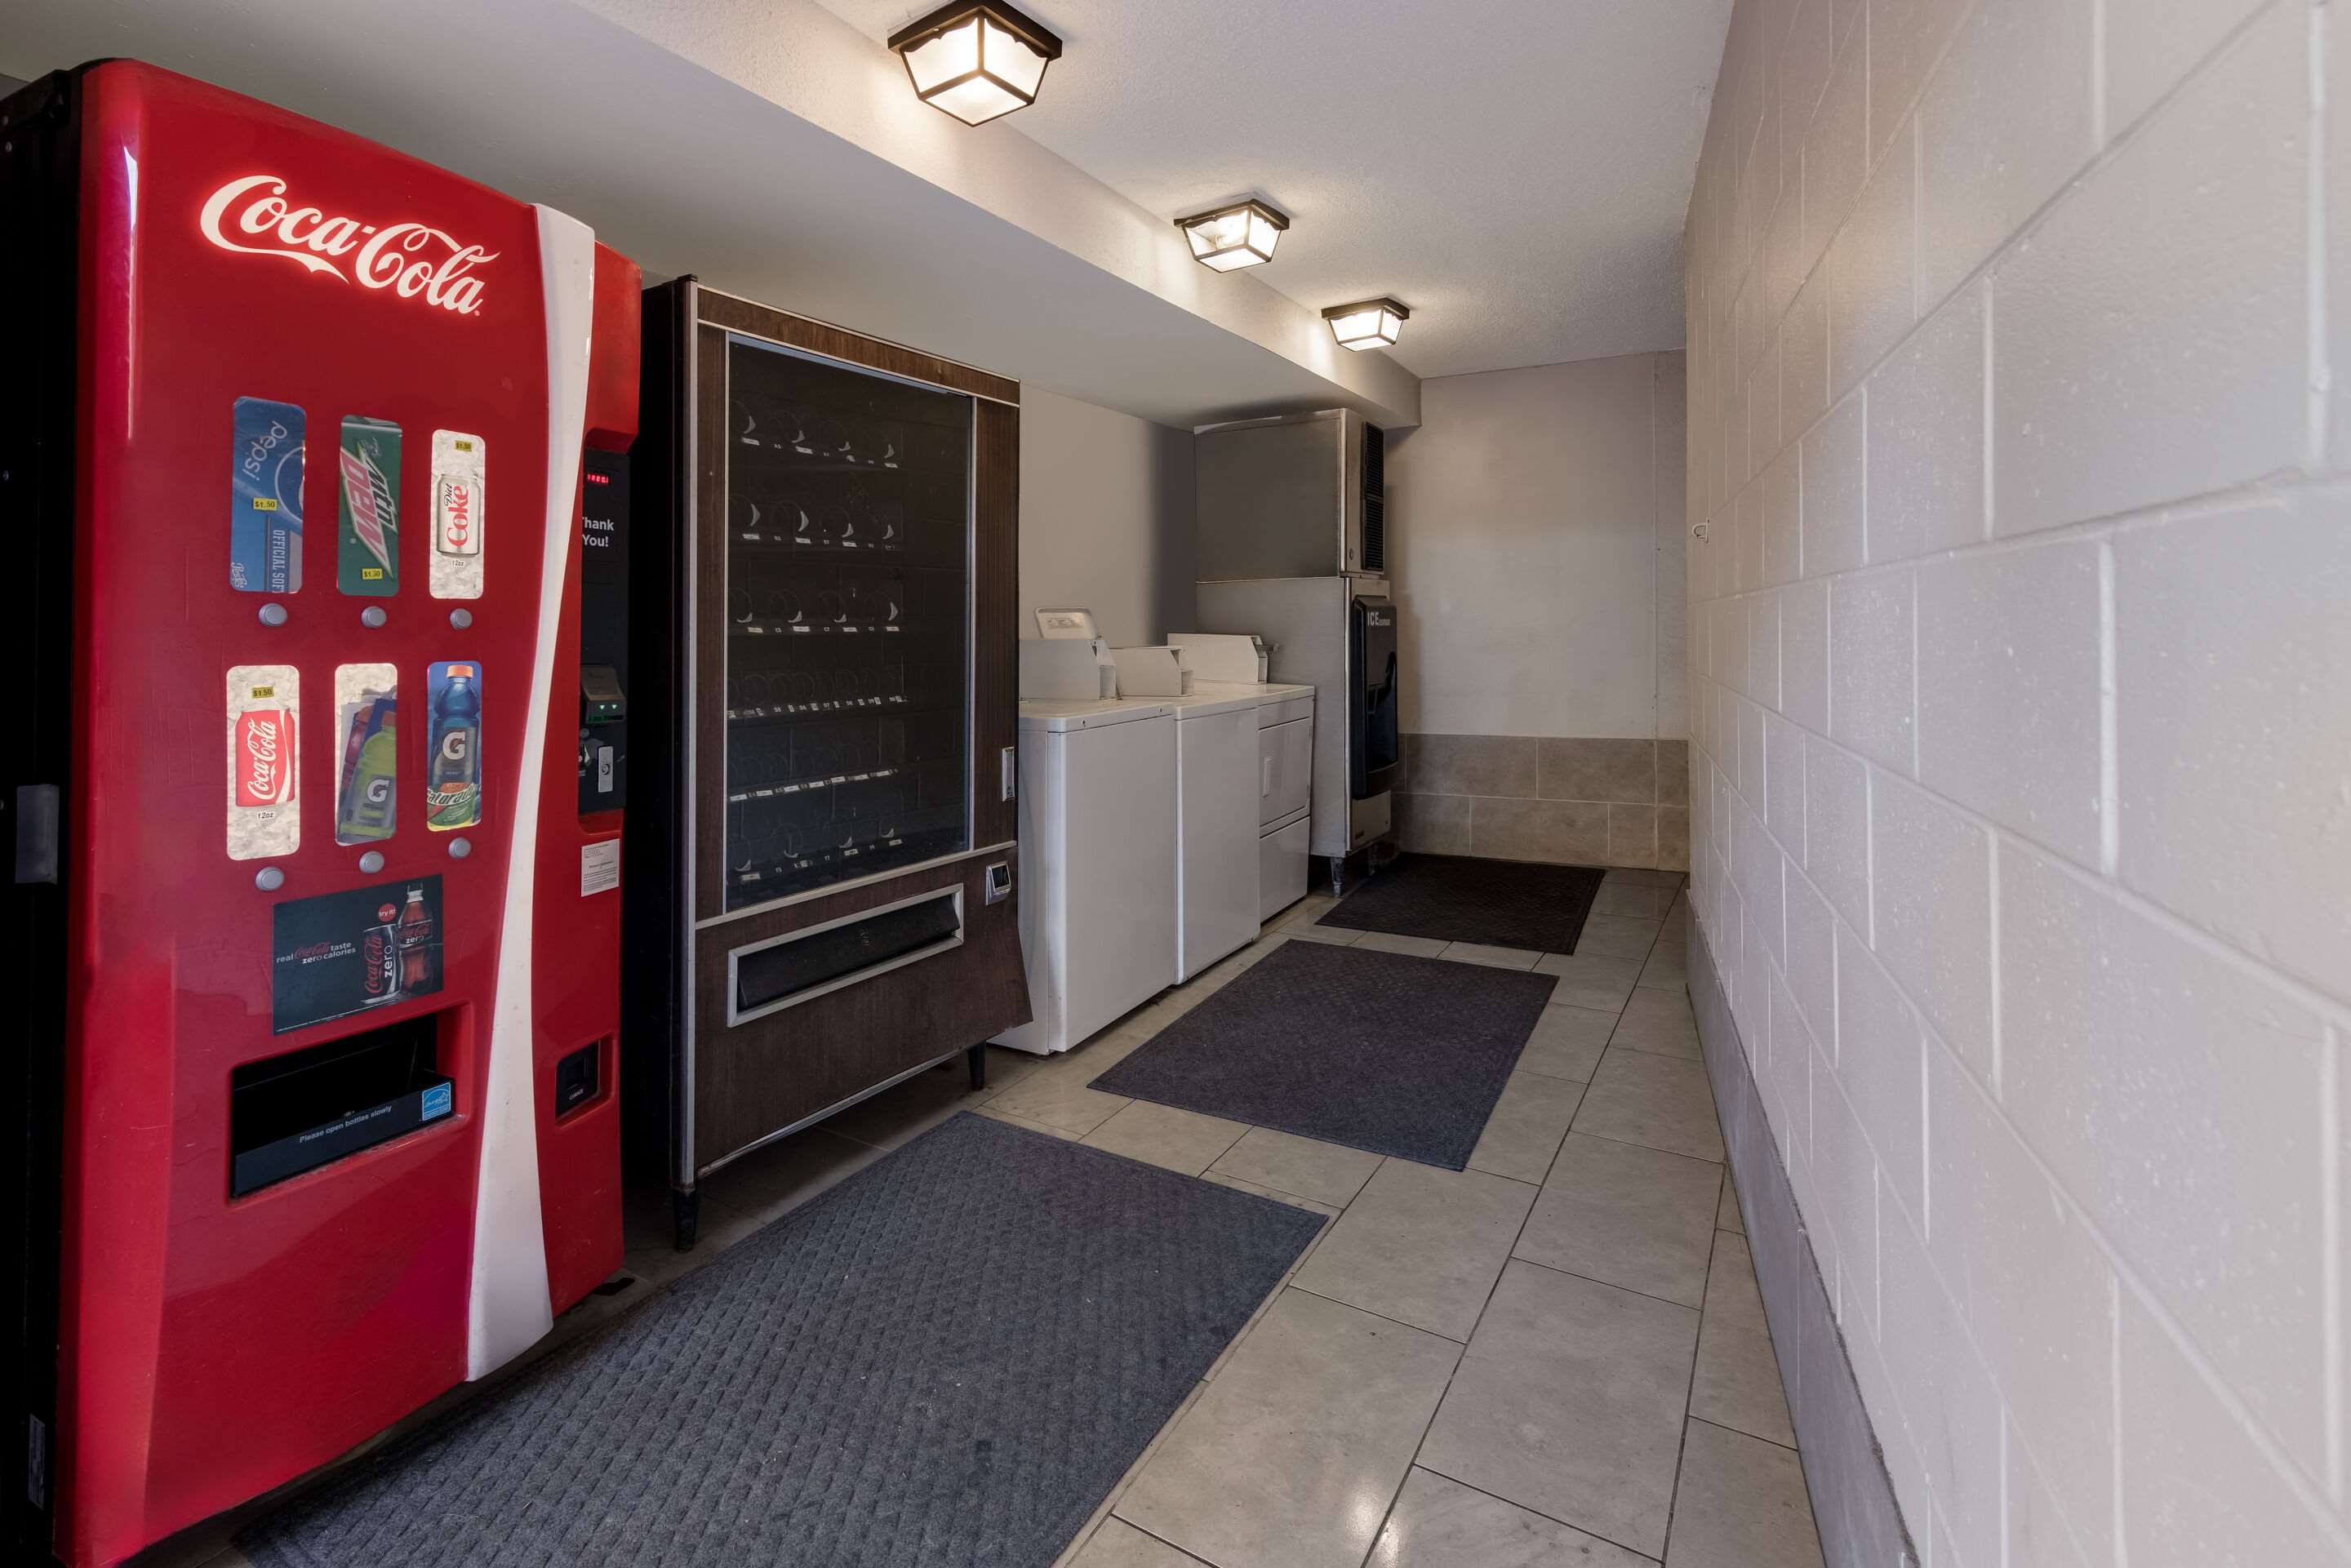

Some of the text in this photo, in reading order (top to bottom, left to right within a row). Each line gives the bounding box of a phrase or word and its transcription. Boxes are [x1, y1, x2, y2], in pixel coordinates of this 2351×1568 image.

[200, 175, 500, 317] Coca-Cola
[242, 420, 288, 482] pepsi
[255, 500, 276, 509] $1.50
[444, 482, 453, 507] Diet
[447, 483, 469, 548] Coke
[582, 517, 615, 531] hank
[273, 530, 287, 571] OFFICIAL
[582, 534, 609, 548] You!
[1367, 611, 1380, 627] ICE
[443, 731, 465, 760] G
[247, 717, 277, 801] Coca-Cola
[367, 779, 390, 802] G
[406, 935, 424, 944] zero
[276, 953, 294, 963] real
[331, 942, 352, 952] taste
[302, 948, 357, 965] zero calories
[384, 945, 393, 978] zero
[300, 1130, 325, 1144] Please
[326, 1122, 344, 1135] open
[345, 1113, 370, 1127] bottles
[371, 1104, 393, 1118] slowly
